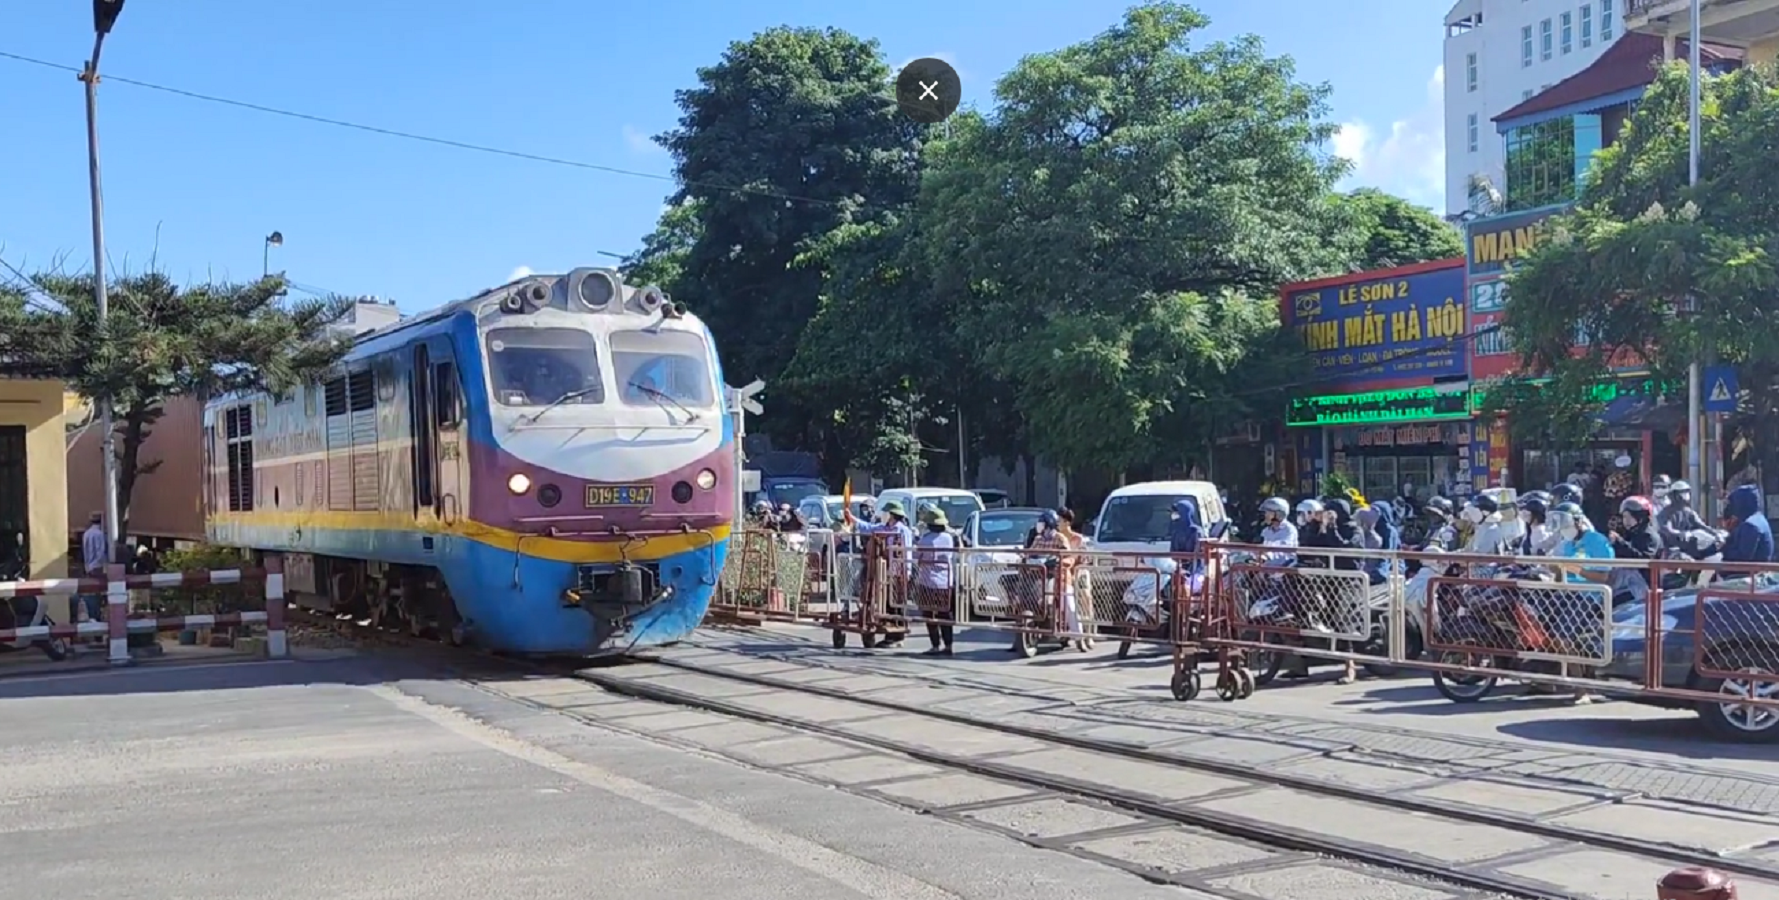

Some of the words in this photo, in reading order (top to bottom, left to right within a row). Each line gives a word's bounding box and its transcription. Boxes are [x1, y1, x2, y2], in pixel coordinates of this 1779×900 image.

[1360, 282, 1394, 302] SƠN
[1398, 281, 1408, 297] 2
[1344, 304, 1386, 348] MẮT
[1392, 304, 1421, 342] HÀ
[1426, 297, 1464, 342] NỘI
[589, 487, 620, 504] D19E
[629, 487, 653, 504] 947
